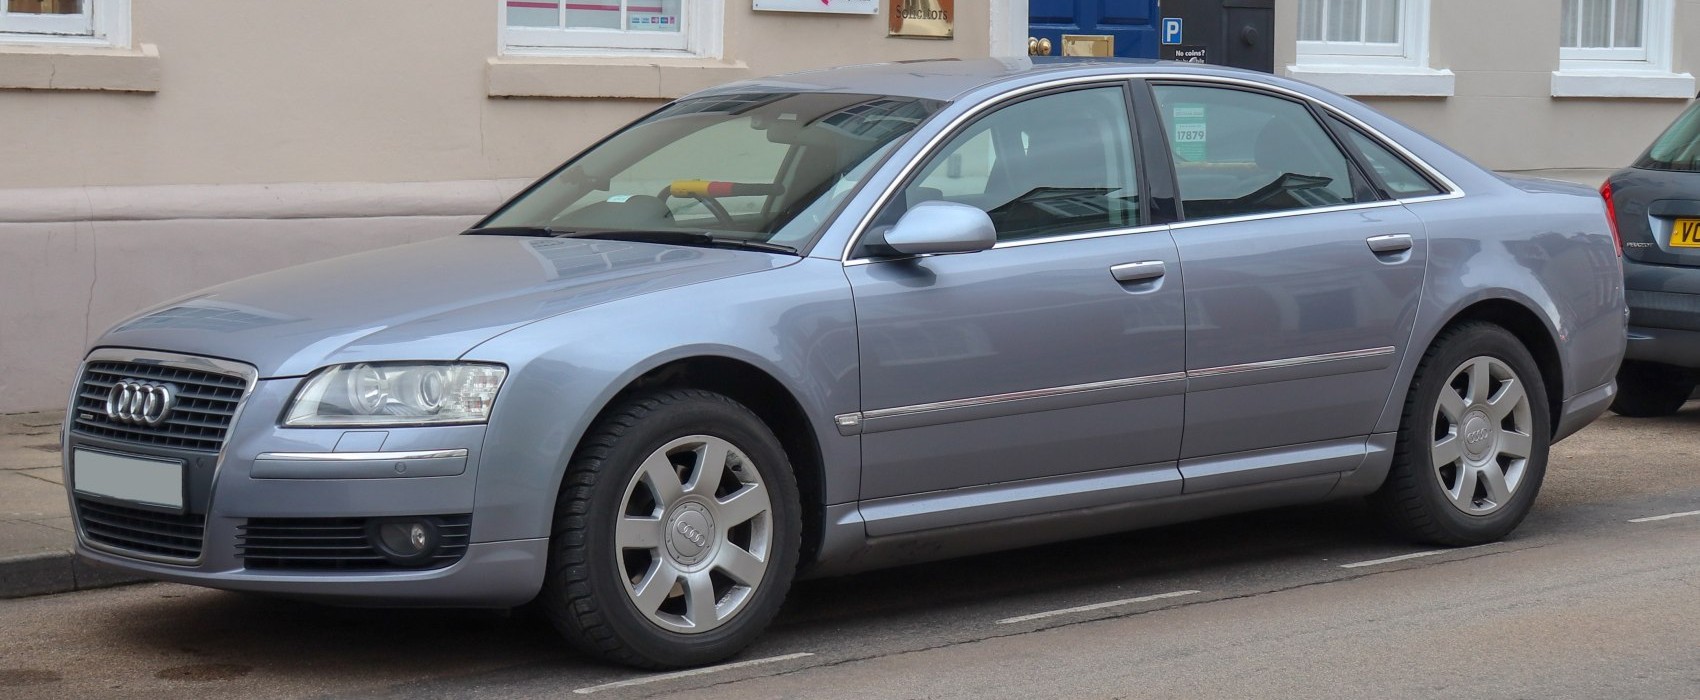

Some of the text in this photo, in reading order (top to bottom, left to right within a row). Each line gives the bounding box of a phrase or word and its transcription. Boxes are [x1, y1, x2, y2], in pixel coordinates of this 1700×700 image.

[896, 5, 948, 20] Solicitors
[1166, 21, 1179, 42] P
[1177, 130, 1205, 141] 17879
